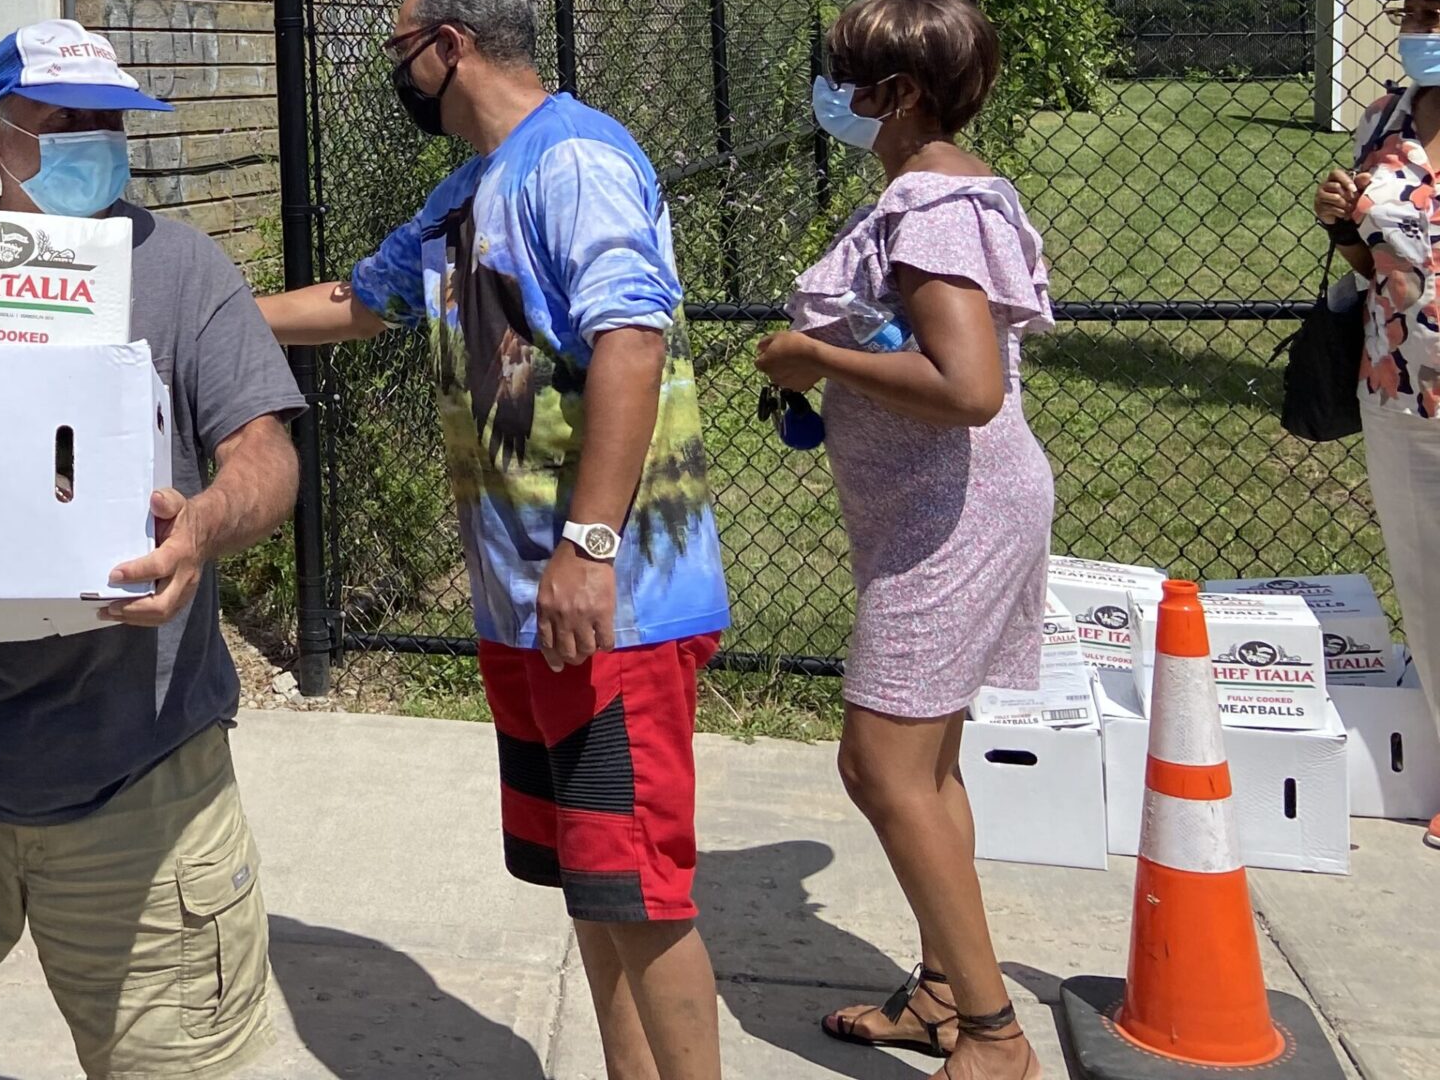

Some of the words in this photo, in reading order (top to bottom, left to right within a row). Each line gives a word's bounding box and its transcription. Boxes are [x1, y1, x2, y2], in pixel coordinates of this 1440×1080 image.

[1108, 631, 1131, 643] ITA
[1082, 651, 1105, 660] ULLY
[1327, 656, 1385, 670] ITALIA
[1213, 667, 1250, 681] HEF
[1255, 669, 1316, 682] ITALIA
[1227, 694, 1254, 702] FULLY
[1256, 696, 1294, 704] COOKED
[1217, 703, 1305, 717] MEATBALLS
